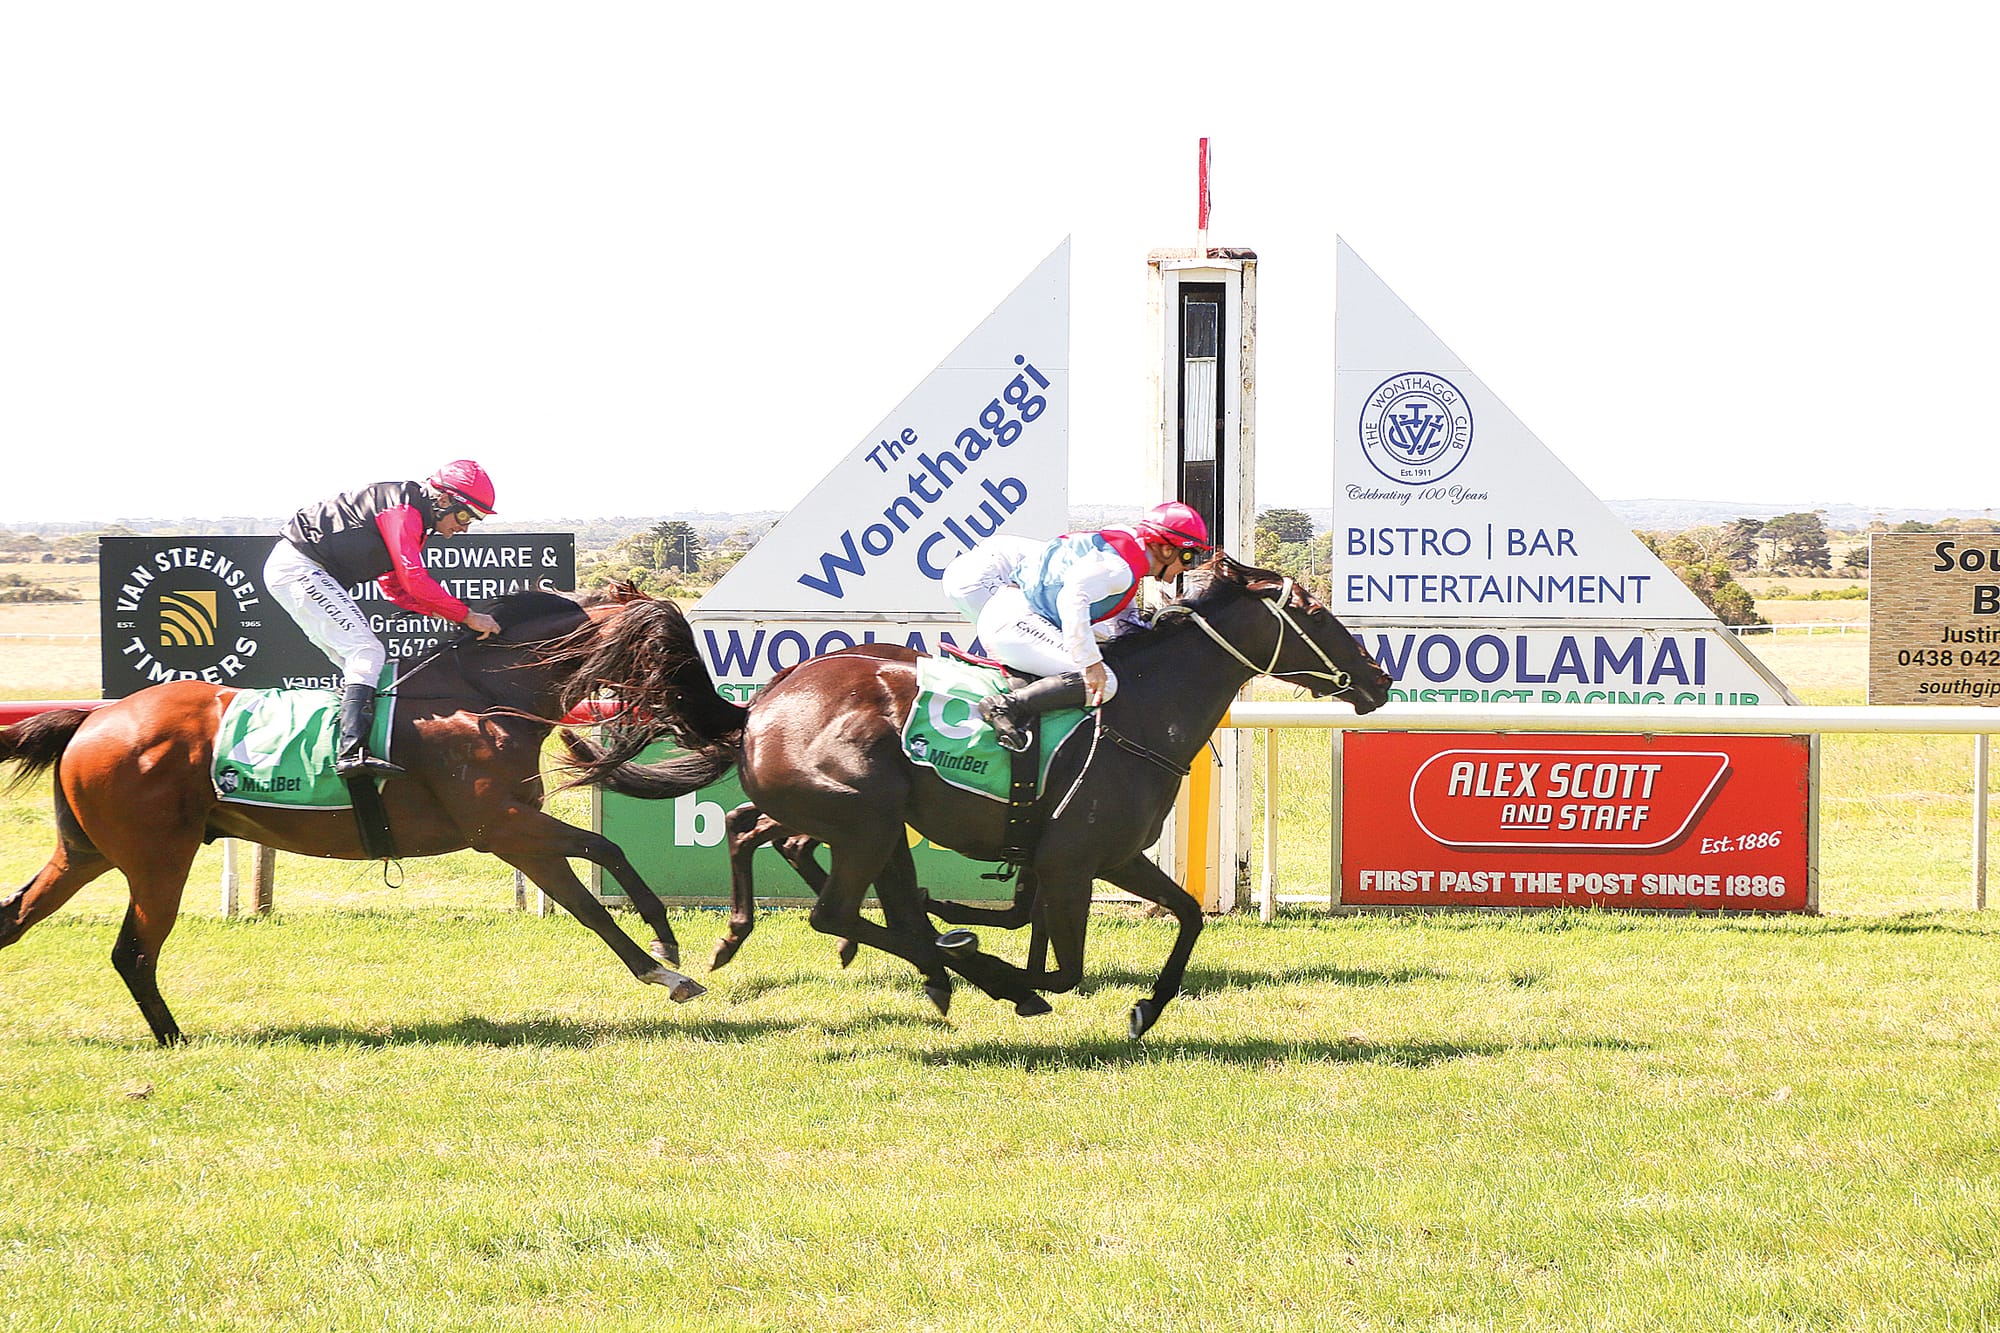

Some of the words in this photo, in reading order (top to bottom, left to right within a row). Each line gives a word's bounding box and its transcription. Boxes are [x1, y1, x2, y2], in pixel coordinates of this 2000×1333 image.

[1372, 378, 1458, 409] WONTHAGGI
[1366, 422, 1379, 448] THE
[1452, 416, 1467, 449] CLUB
[865, 427, 919, 474] The
[797, 354, 1051, 600] Wonthaggi
[1346, 484, 1412, 506] Celebrating
[1418, 487, 1447, 500] 100
[1448, 484, 1488, 505] Years
[916, 477, 1028, 580] Club
[1347, 528, 1472, 556] BISTRO
[1507, 528, 1579, 557] BAR
[541, 546, 559, 568] &
[116, 565, 156, 611] VAN
[155, 547, 260, 612] STEENSEL
[1347, 575, 1651, 604] ENTERTAINMENT
[116, 621, 136, 629] EST.
[1353, 634, 1707, 686] WOOLAMAI
[1898, 650, 1953, 667] 0438
[1960, 650, 2000, 667] 042
[929, 748, 989, 775] MintBet
[1448, 761, 1541, 797] ALEX
[1547, 763, 1662, 799] SCOTT
[1500, 804, 1553, 824] AND
[1558, 805, 1650, 831] STAFF
[1360, 869, 1435, 892] FIRST
[1439, 870, 1506, 893] PAST
[1511, 872, 1562, 894] THE
[1568, 873, 1637, 896] POST
[1642, 874, 1720, 897] SINCE
[1725, 875, 1786, 898] 1886
